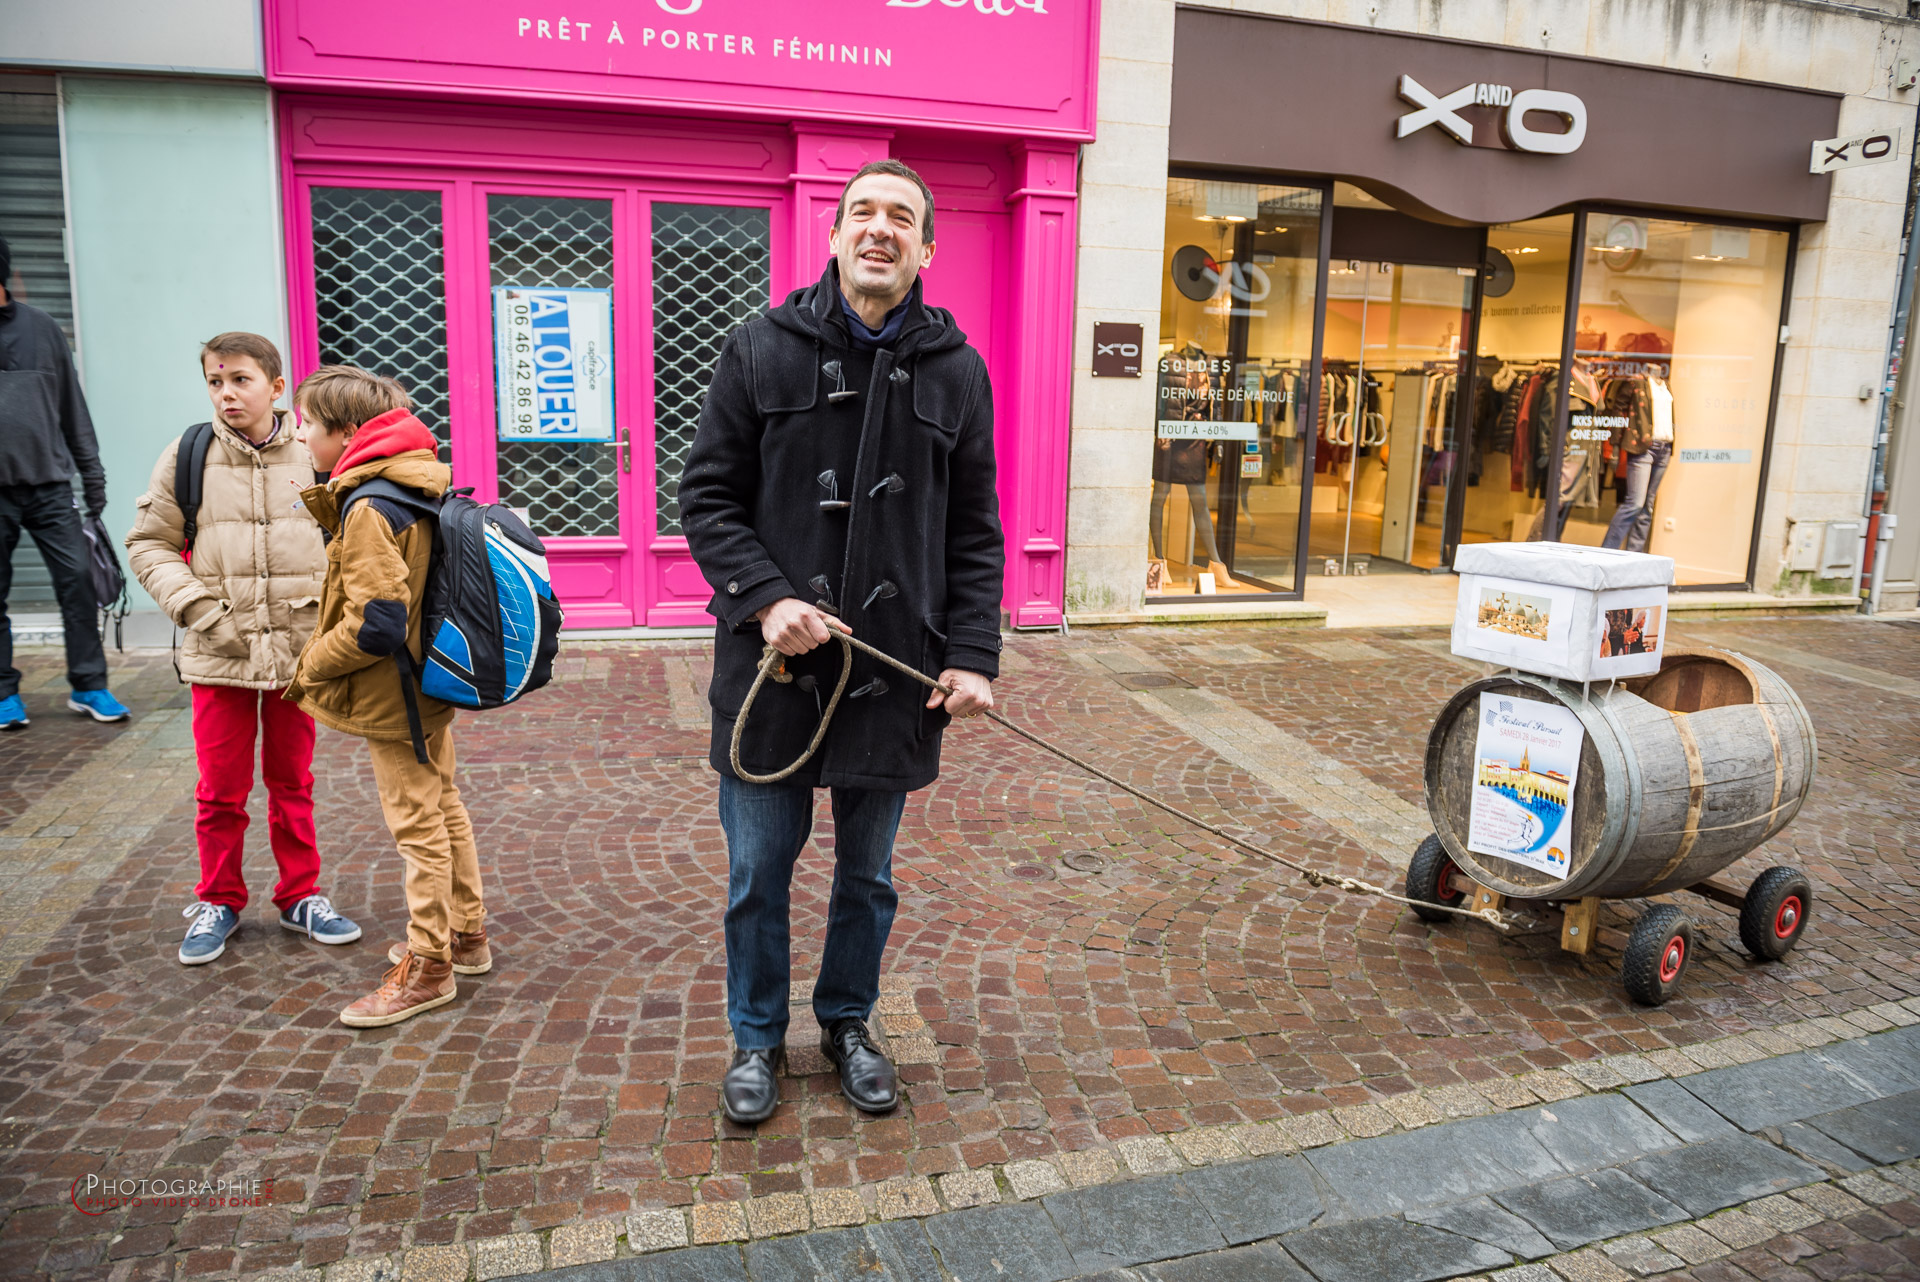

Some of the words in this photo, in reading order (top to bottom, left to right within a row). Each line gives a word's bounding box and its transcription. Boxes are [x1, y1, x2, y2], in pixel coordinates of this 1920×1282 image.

[518, 16, 592, 42] PRÊT
[607, 20, 625, 45] À
[643, 27, 756, 56] PORTER
[773, 36, 892, 67] FÉMININ
[1397, 74, 1477, 144] X
[1475, 82, 1513, 107] AND
[1507, 88, 1588, 154] O
[1824, 142, 1850, 165] X
[1862, 135, 1892, 159] O
[514, 305, 529, 326] 06
[530, 296, 568, 320] A
[1521, 304, 1562, 316] collection
[515, 332, 530, 353] 46
[516, 360, 531, 381] 42
[588, 341, 596, 391] capifrance
[1160, 359, 1231, 373] SOLDES
[533, 326, 578, 433] LOUER
[517, 387, 532, 407] 86
[1161, 385, 1224, 401] DERNIÈRE
[1227, 387, 1294, 403] DÉMARQUE
[518, 414, 533, 434] 98
[1161, 424, 1188, 435] TOUT
[1191, 422, 1199, 435] À
[1202, 425, 1229, 436] -60%
[1572, 415, 1592, 427] IKKS
[1594, 416, 1630, 428] WOMEN
[1570, 429, 1591, 441] ONE
[1592, 430, 1612, 441] STEP
[1681, 451, 1702, 460] TOUT
[1704, 450, 1710, 460] À
[1712, 451, 1731, 460] -60%
[1499, 715, 1531, 729] Festival
[1532, 720, 1563, 736] Pursuit
[1499, 727, 1521, 739] SAMEDI
[1522, 732, 1529, 741] 28
[1548, 739, 1562, 749] 2017
